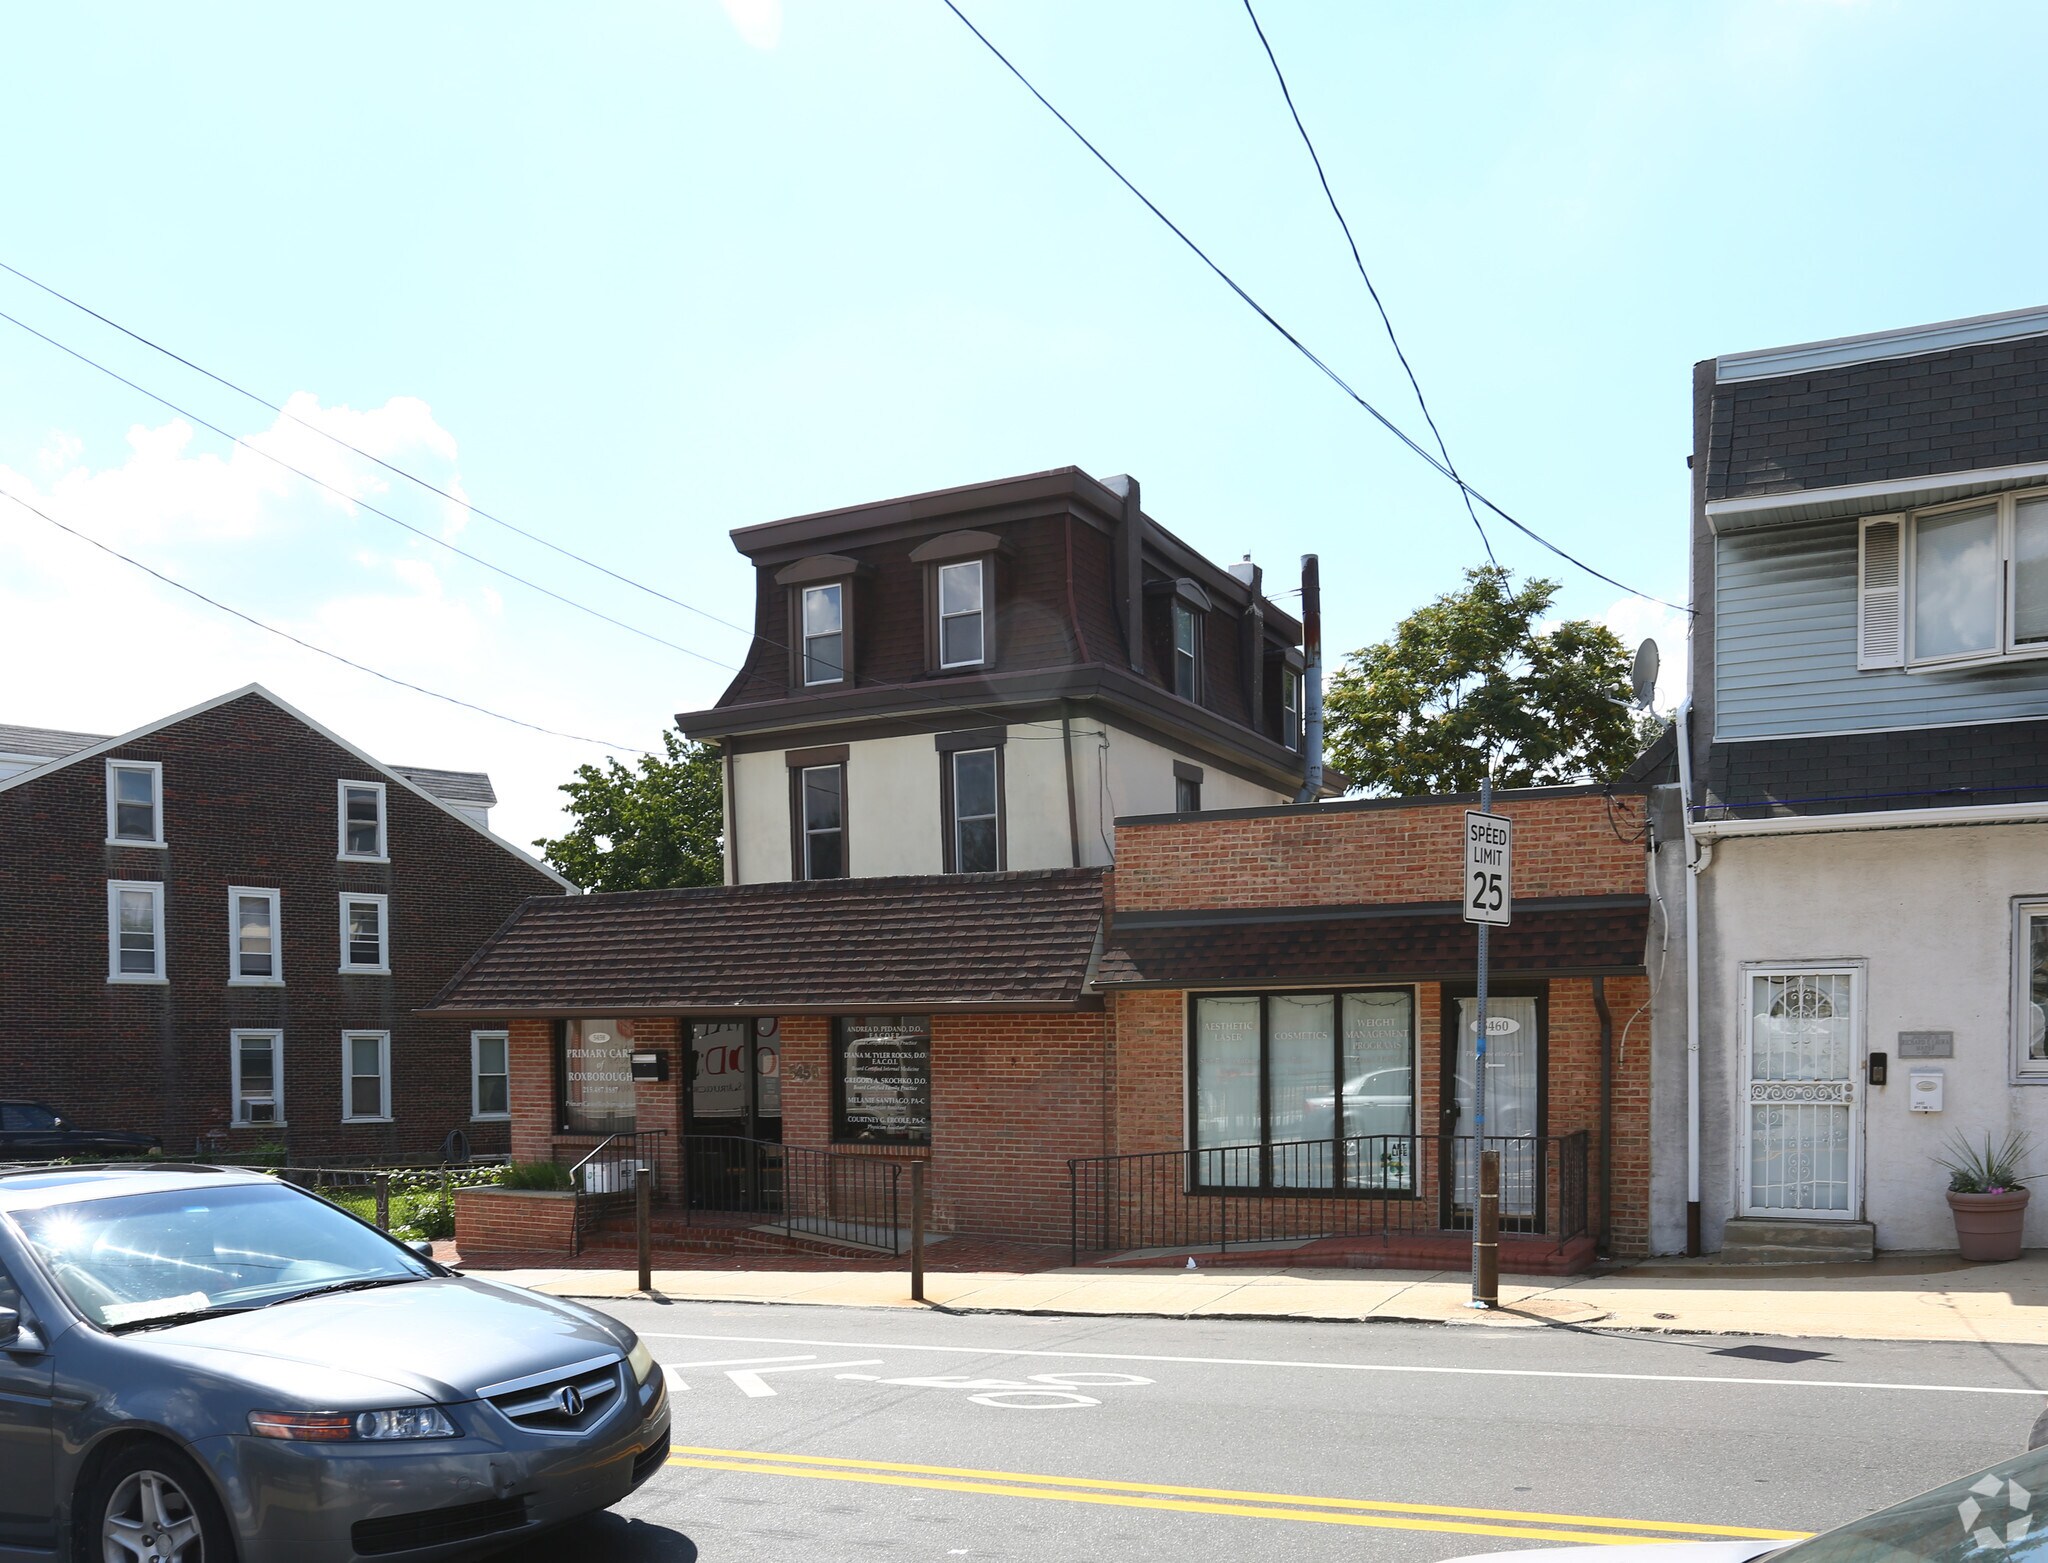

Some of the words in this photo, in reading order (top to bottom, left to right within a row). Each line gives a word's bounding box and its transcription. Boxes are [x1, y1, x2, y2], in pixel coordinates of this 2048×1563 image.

[1470, 824, 1507, 846] SPEED
[1474, 846, 1503, 866] LIMIT
[1472, 871, 1503, 911] 25
[1204, 1021, 1254, 1031] AESTHETIC
[1357, 1018, 1396, 1027] WEIGHT
[1484, 1020, 1509, 1031] 460
[1214, 1033, 1243, 1041] LASER
[1274, 1031, 1328, 1040] COSMETICS
[1345, 1029, 1409, 1039] MANAGEMENT
[1352, 1040, 1402, 1050] PROGRAMS
[566, 1048, 608, 1058] PRIMARY
[596, 1060, 605, 1071] of
[568, 1072, 633, 1082] ROXBOROUGH
[911, 1097, 925, 1105] PA-C
